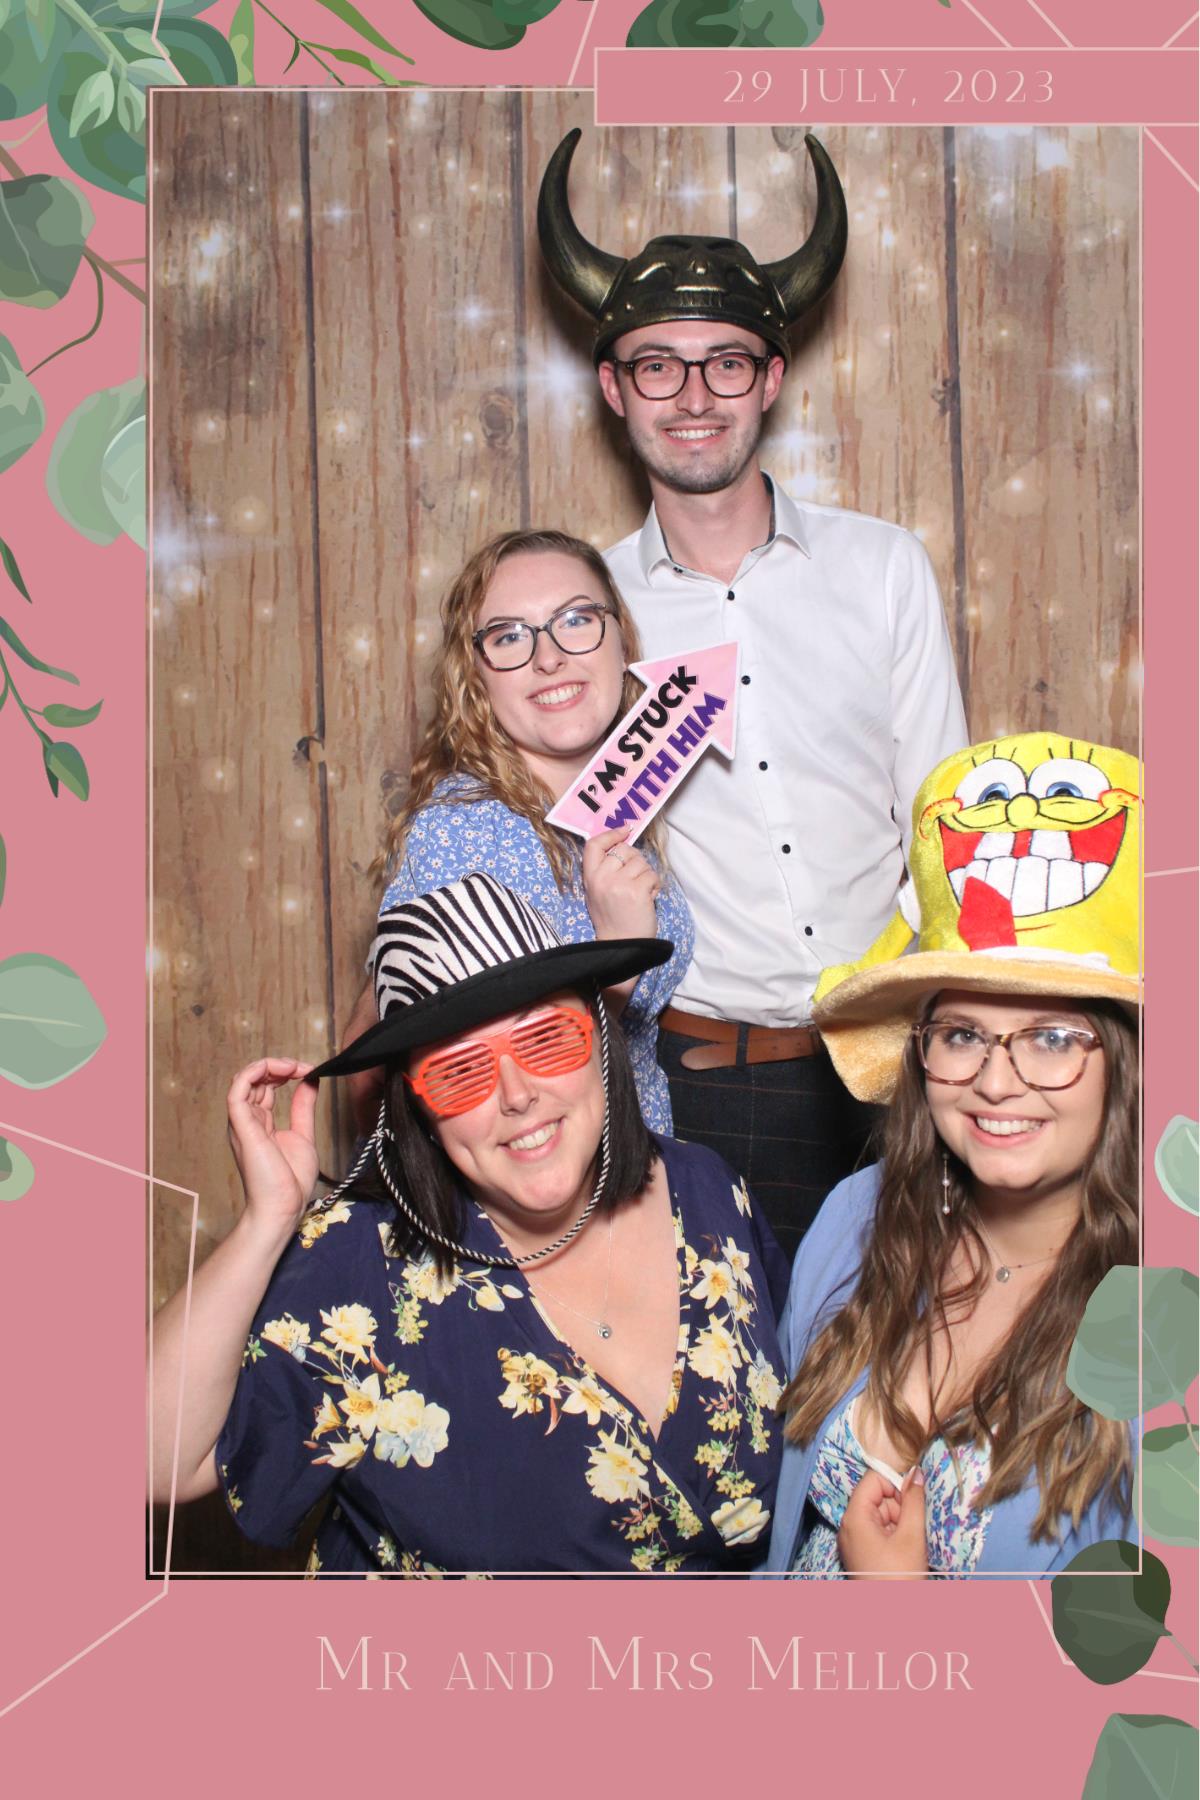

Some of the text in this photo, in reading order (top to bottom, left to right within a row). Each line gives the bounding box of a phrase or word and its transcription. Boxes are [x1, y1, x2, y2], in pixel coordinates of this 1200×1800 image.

[577, 665, 698, 814] I'M STUCK
[604, 692, 728, 830] WITH HIM
